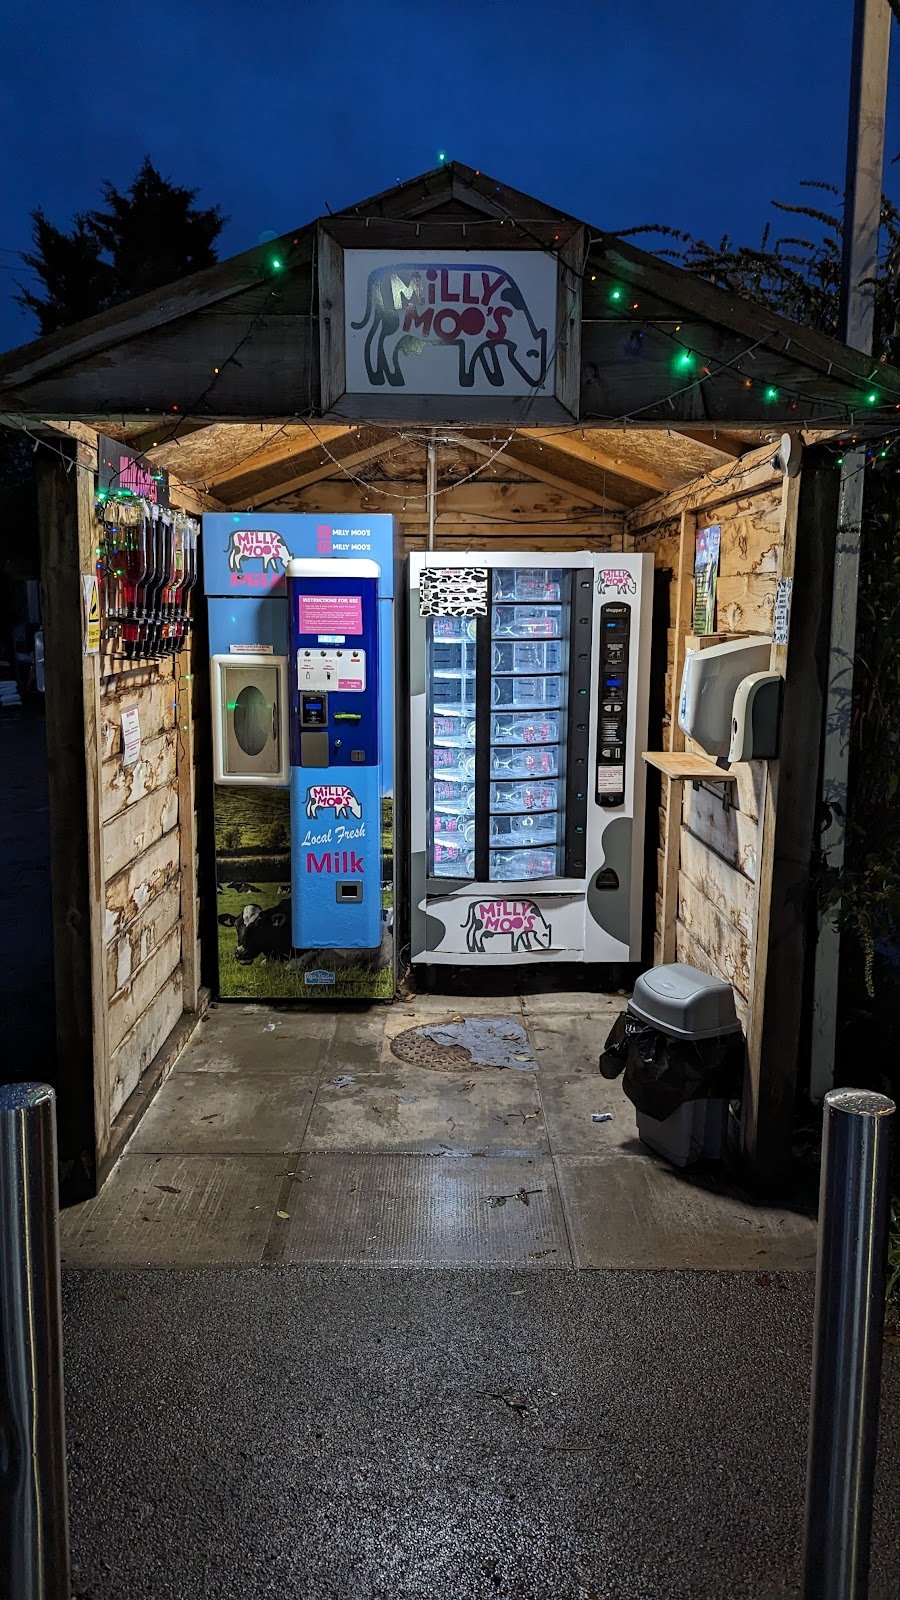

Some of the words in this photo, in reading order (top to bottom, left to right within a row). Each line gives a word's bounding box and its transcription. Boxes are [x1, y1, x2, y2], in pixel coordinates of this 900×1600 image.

[402, 302, 513, 341] MOO'S
[350, 529, 371, 537] MOO'S
[242, 544, 281, 557] MOO'S
[350, 543, 371, 551] MOO'S
[317, 796, 352, 807] MOO'S
[301, 828, 333, 847] Local
[335, 822, 366, 844] Fresh
[306, 851, 364, 874] Milk
[484, 915, 536, 932] MOO'S
